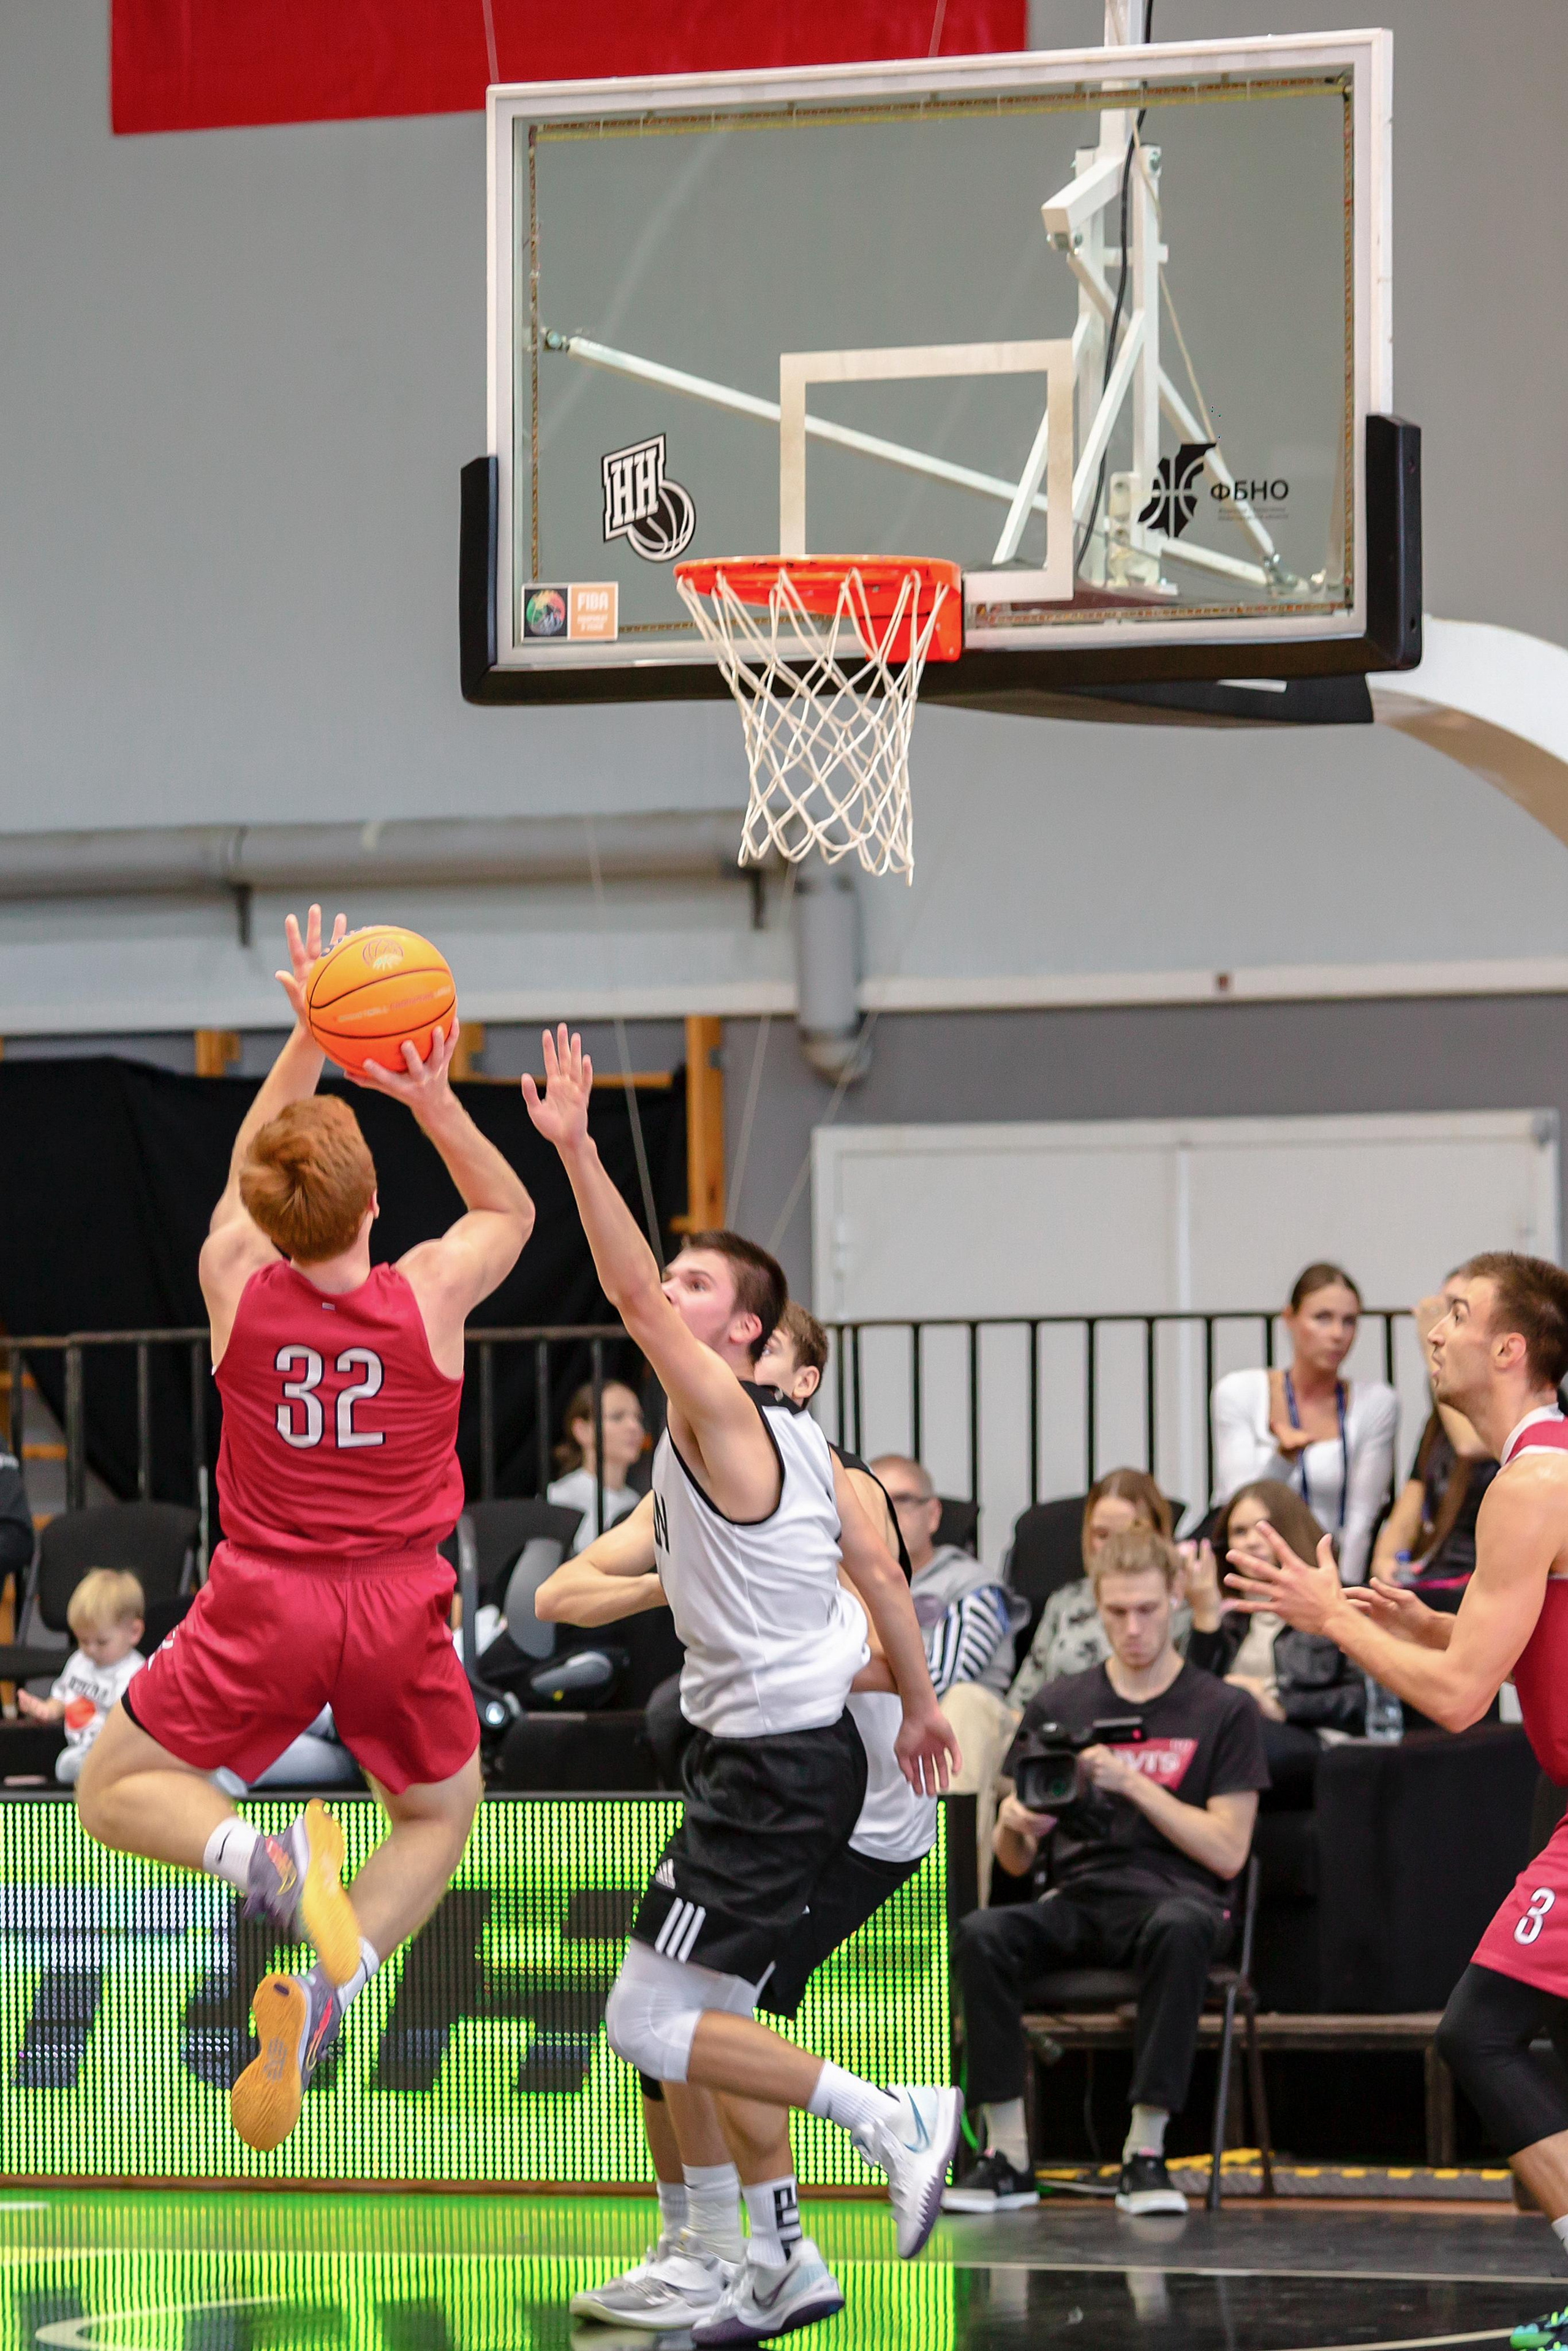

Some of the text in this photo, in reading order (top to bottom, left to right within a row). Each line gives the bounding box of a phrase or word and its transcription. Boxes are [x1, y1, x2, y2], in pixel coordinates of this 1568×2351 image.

[1210, 479, 1289, 502] ФБНО
[578, 591, 609, 611] FIBA
[274, 1344, 386, 1449] 32
[1513, 1886, 1556, 1945] 3
